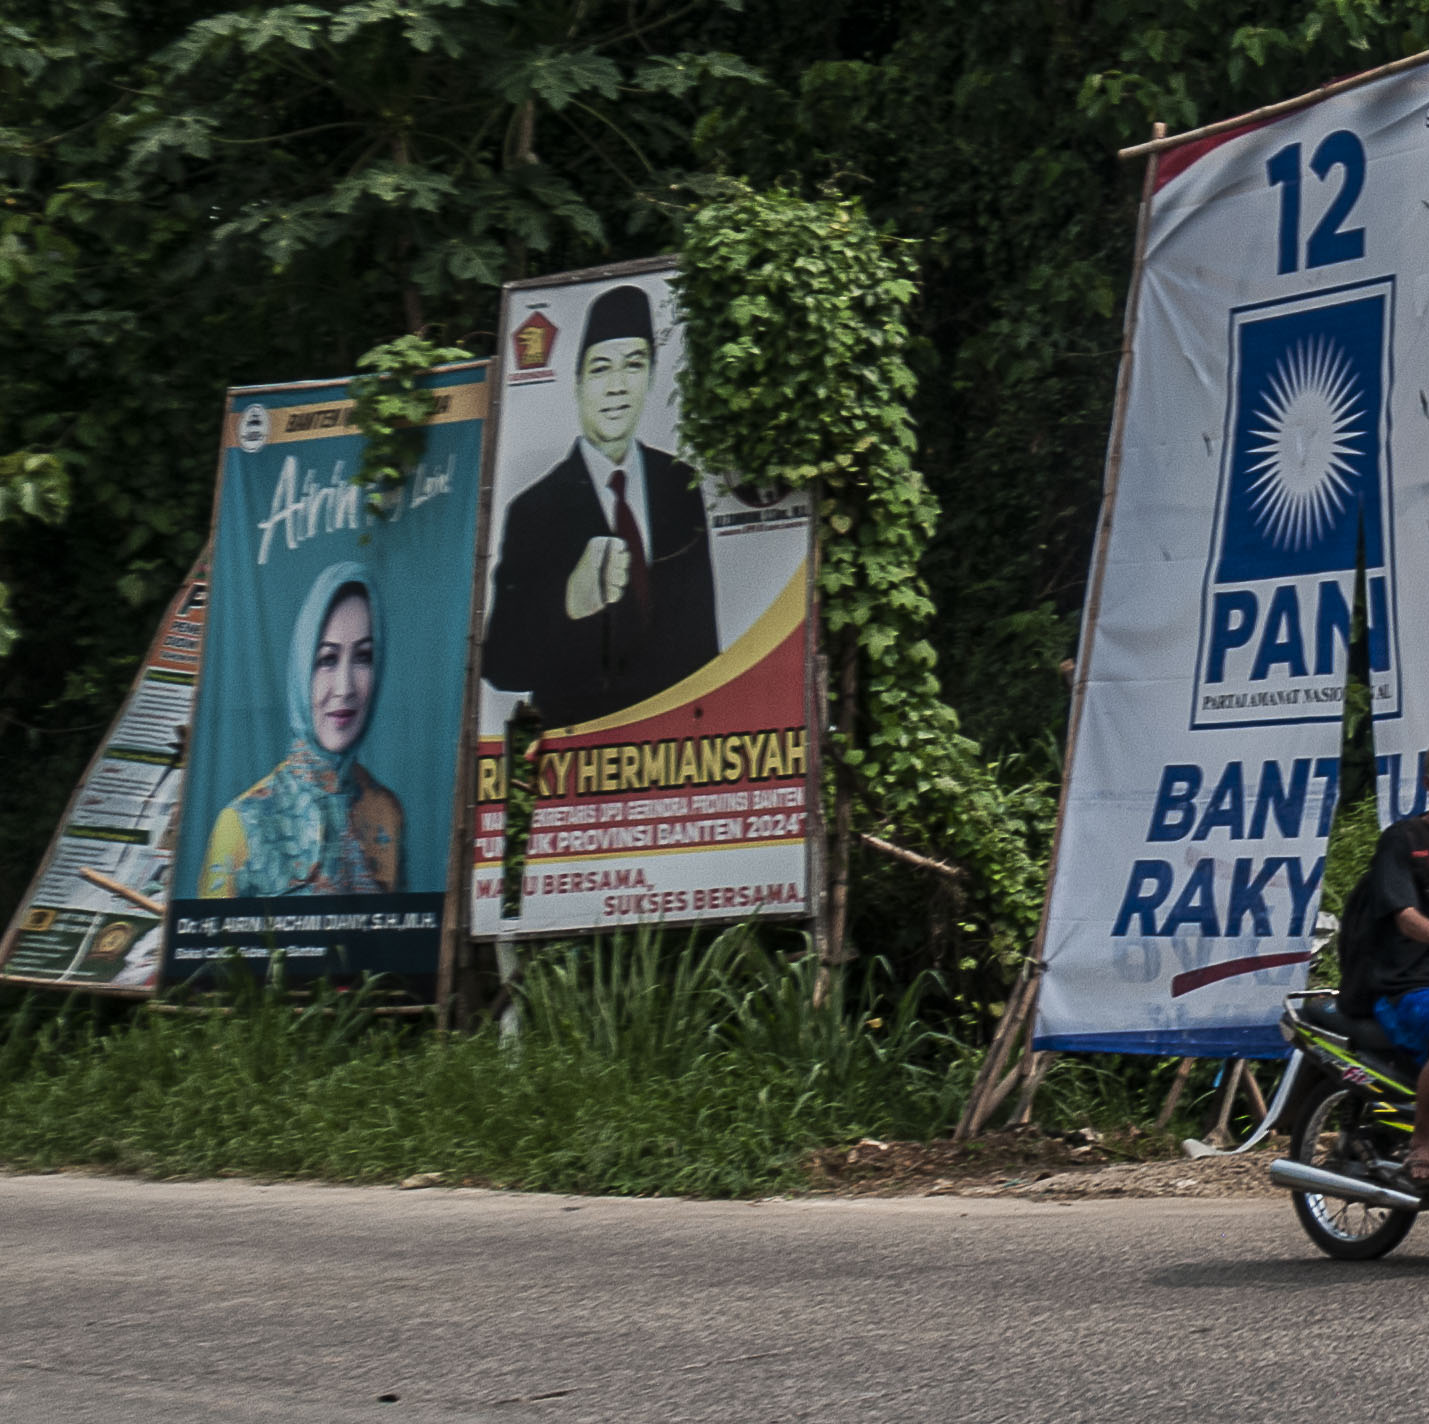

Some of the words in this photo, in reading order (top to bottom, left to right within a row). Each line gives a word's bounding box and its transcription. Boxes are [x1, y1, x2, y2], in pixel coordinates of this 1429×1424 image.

[1266, 129, 1367, 275] 12
[257, 455, 360, 565] Airin
[1205, 575, 1391, 684] PAN
[576, 726, 807, 796] HERMIANSYAH
[752, 785, 805, 810] BANTEN
[555, 824, 653, 854] PROVINSI
[657, 818, 743, 847] BANTEN
[542, 867, 656, 897] BERSAMA,
[602, 890, 688, 917] SUKSES
[1111, 857, 1326, 938] RAKY
